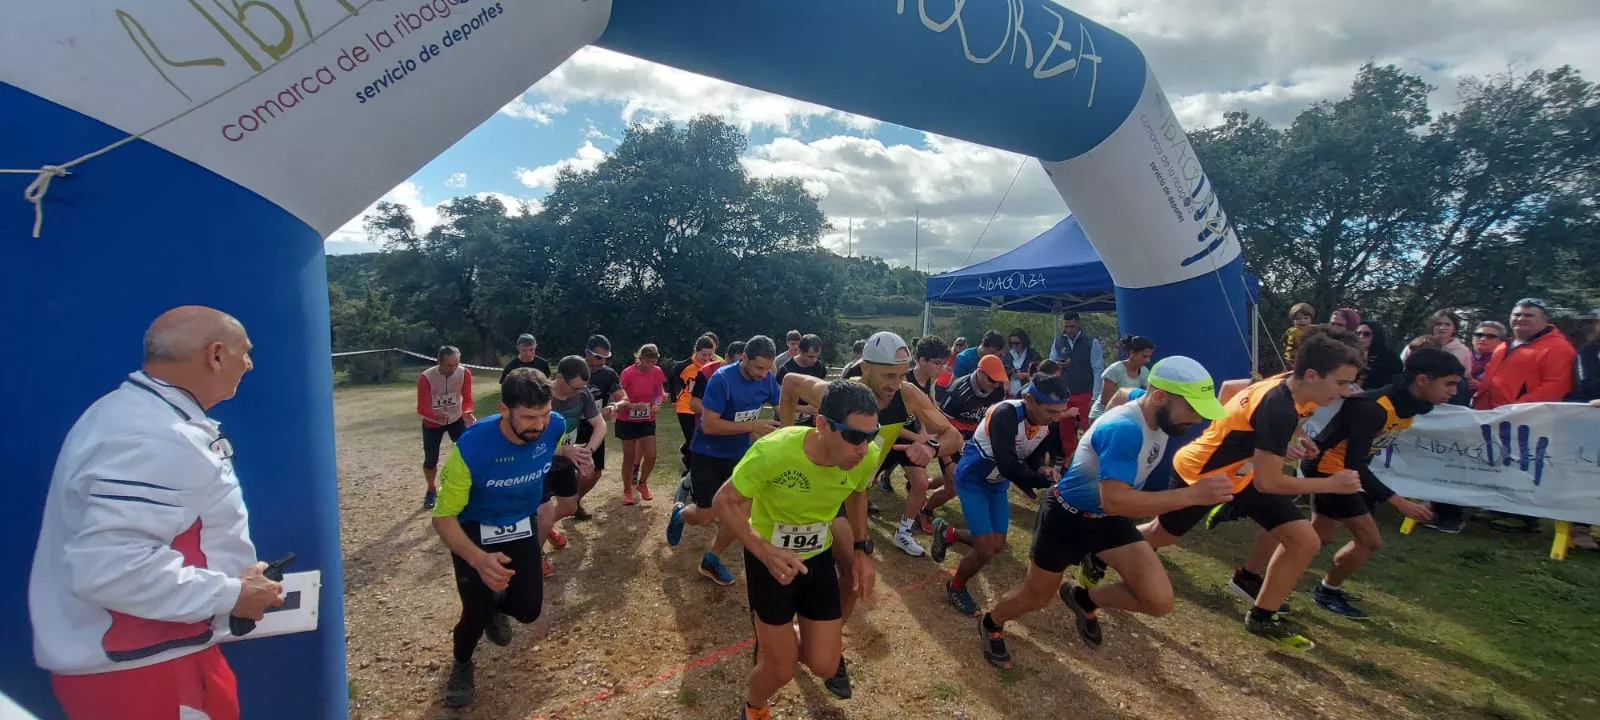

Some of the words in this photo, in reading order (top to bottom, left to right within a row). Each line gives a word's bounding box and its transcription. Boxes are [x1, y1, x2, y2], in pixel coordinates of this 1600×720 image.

[355, 58, 417, 104] servicio
[418, 44, 441, 64] de
[441, 2, 505, 48] deportes
[222, 66, 336, 142] comarca
[336, 46, 370, 72] de
[364, 29, 396, 53] la
[1149, 160, 1167, 187] servicio
[1161, 185, 1172, 196] de
[1160, 154, 1171, 168] de
[780, 534, 819, 549] 194
